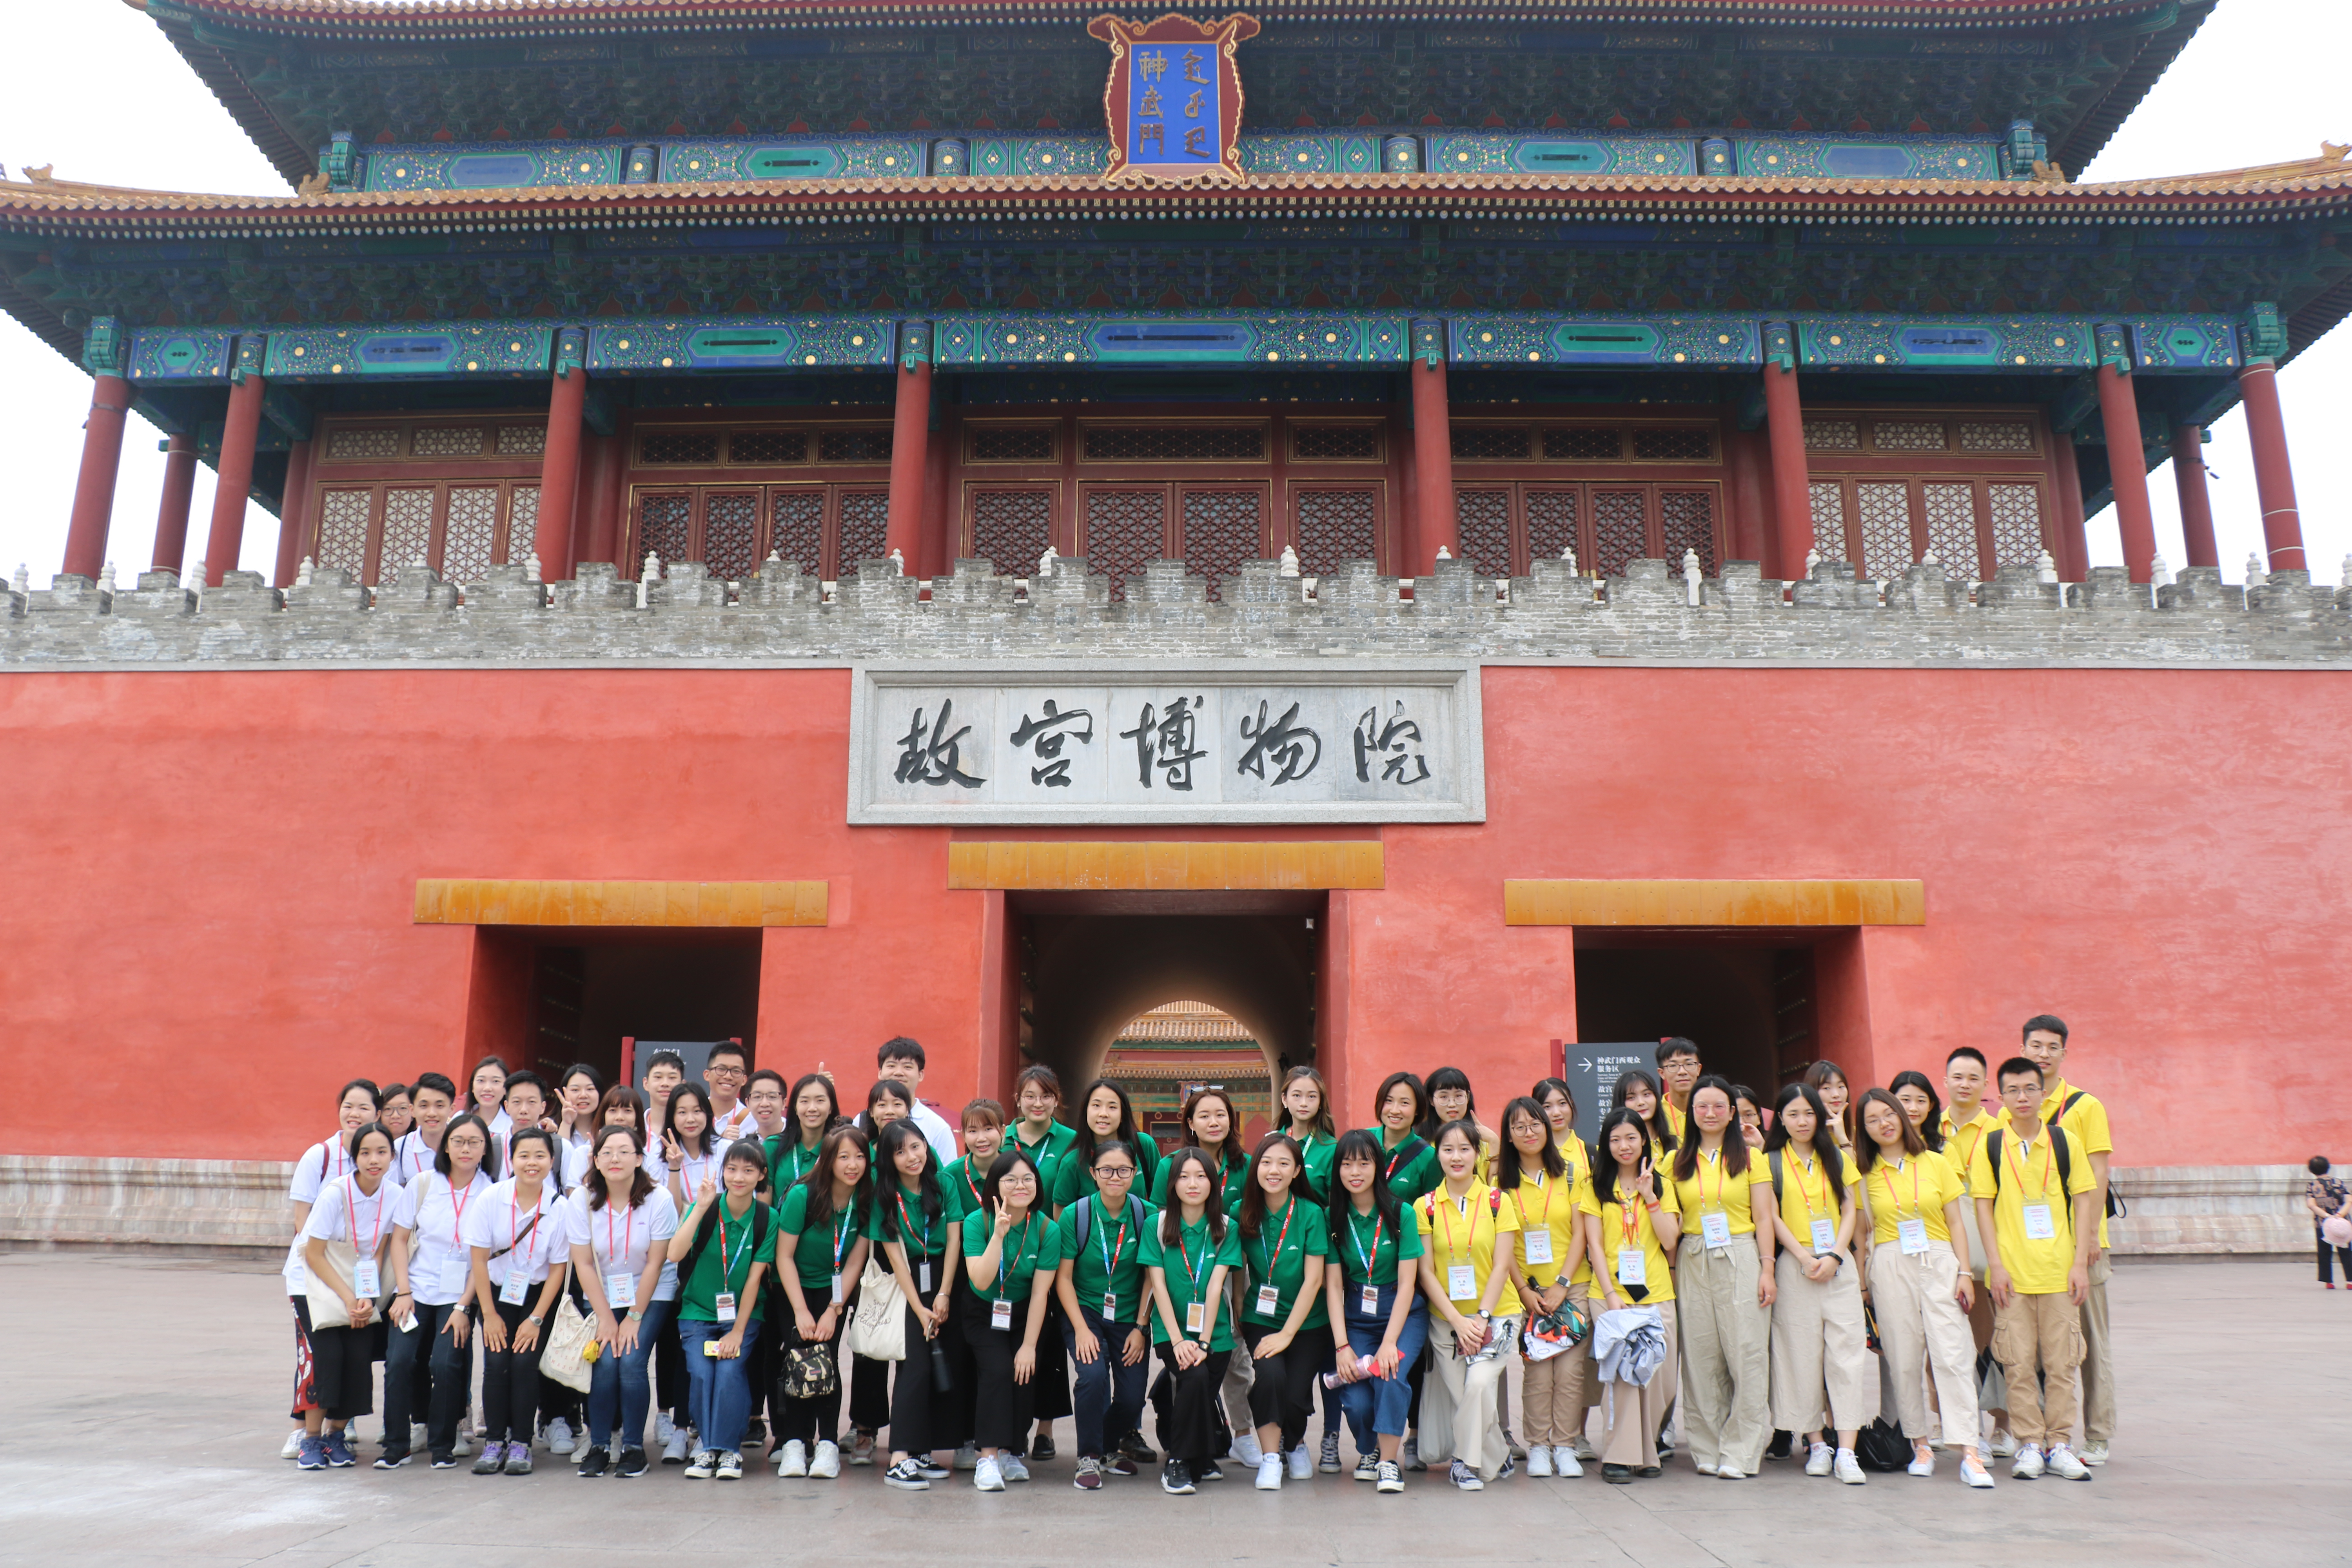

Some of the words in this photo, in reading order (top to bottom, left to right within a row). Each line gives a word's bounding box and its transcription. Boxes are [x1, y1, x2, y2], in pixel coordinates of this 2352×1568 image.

[1138, 49, 1168, 155] 神武門
[894, 696, 1430, 792] 故宫博物院
